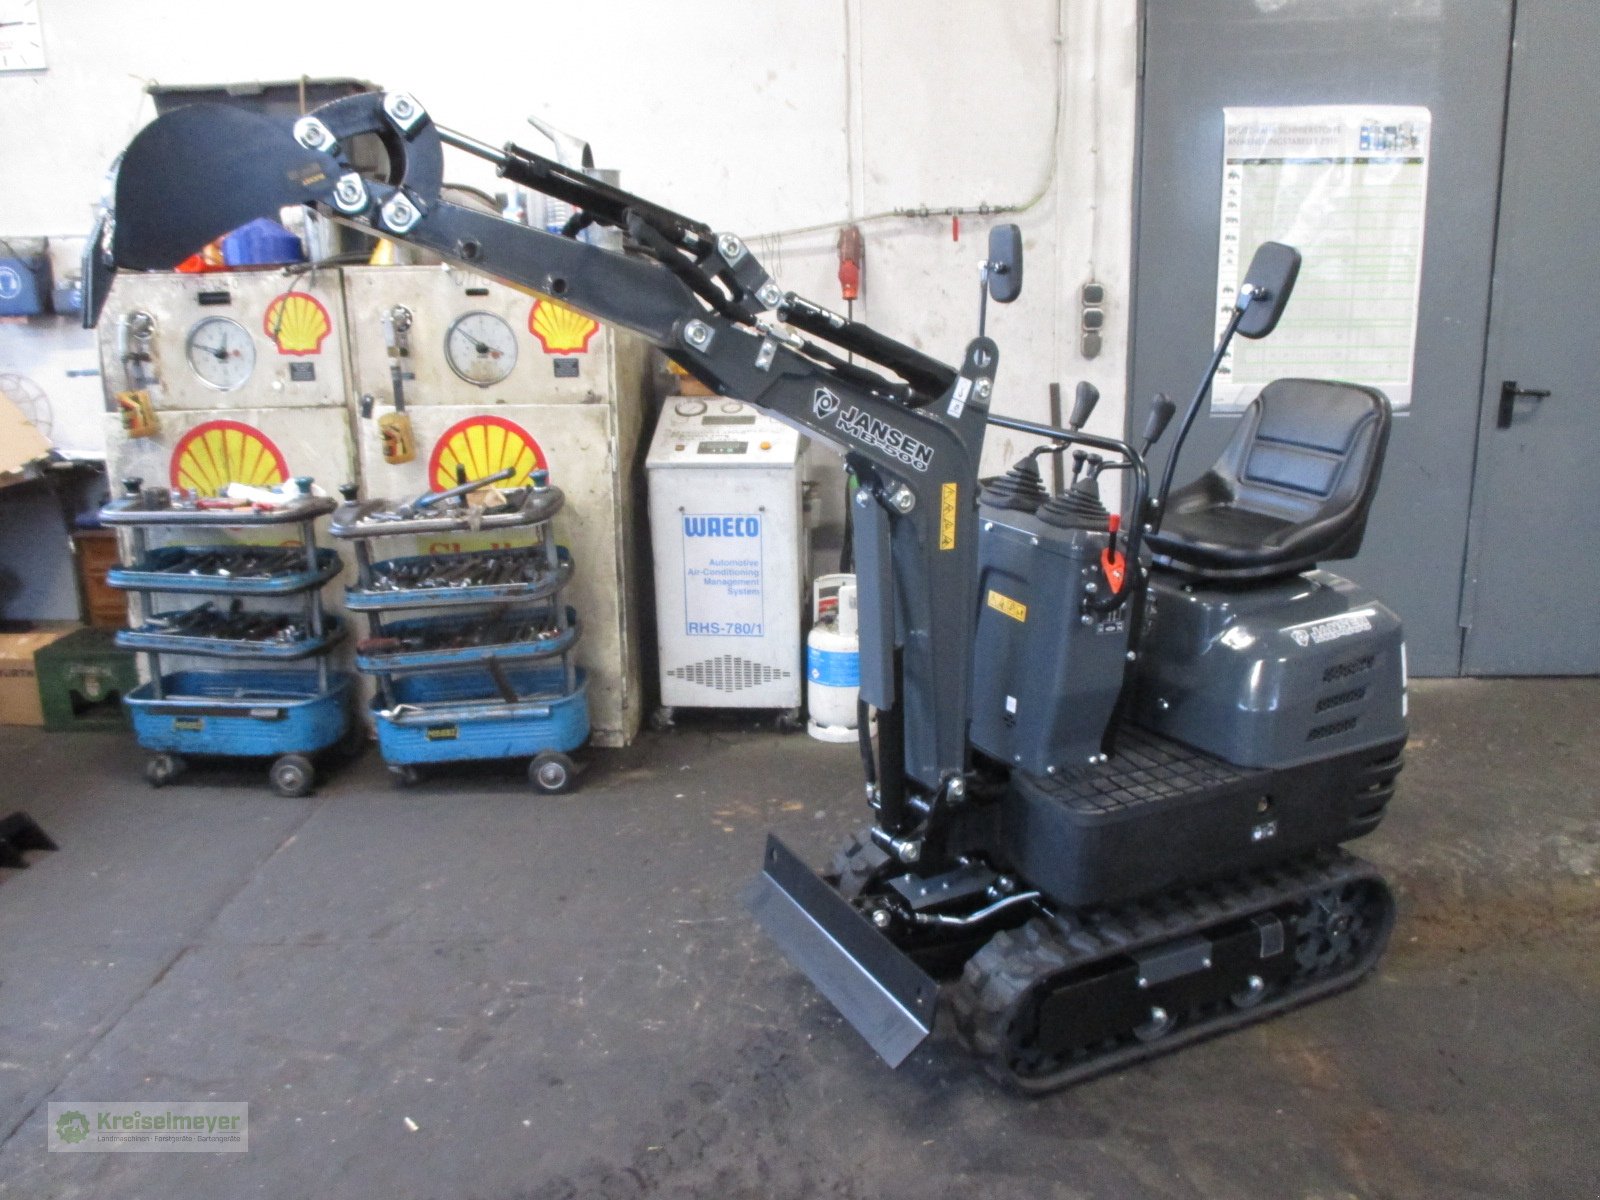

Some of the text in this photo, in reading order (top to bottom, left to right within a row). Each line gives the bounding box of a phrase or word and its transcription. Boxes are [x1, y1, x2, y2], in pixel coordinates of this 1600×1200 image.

[839, 405, 935, 464] JANSEN
[836, 418, 929, 472] MB-500
[684, 516, 759, 538] WAECO
[709, 558, 760, 567] Automotive
[687, 567, 760, 578] Air-Conditioning
[703, 577, 760, 587] Management
[727, 587, 761, 597] System
[688, 621, 763, 635] RHS-780/1
